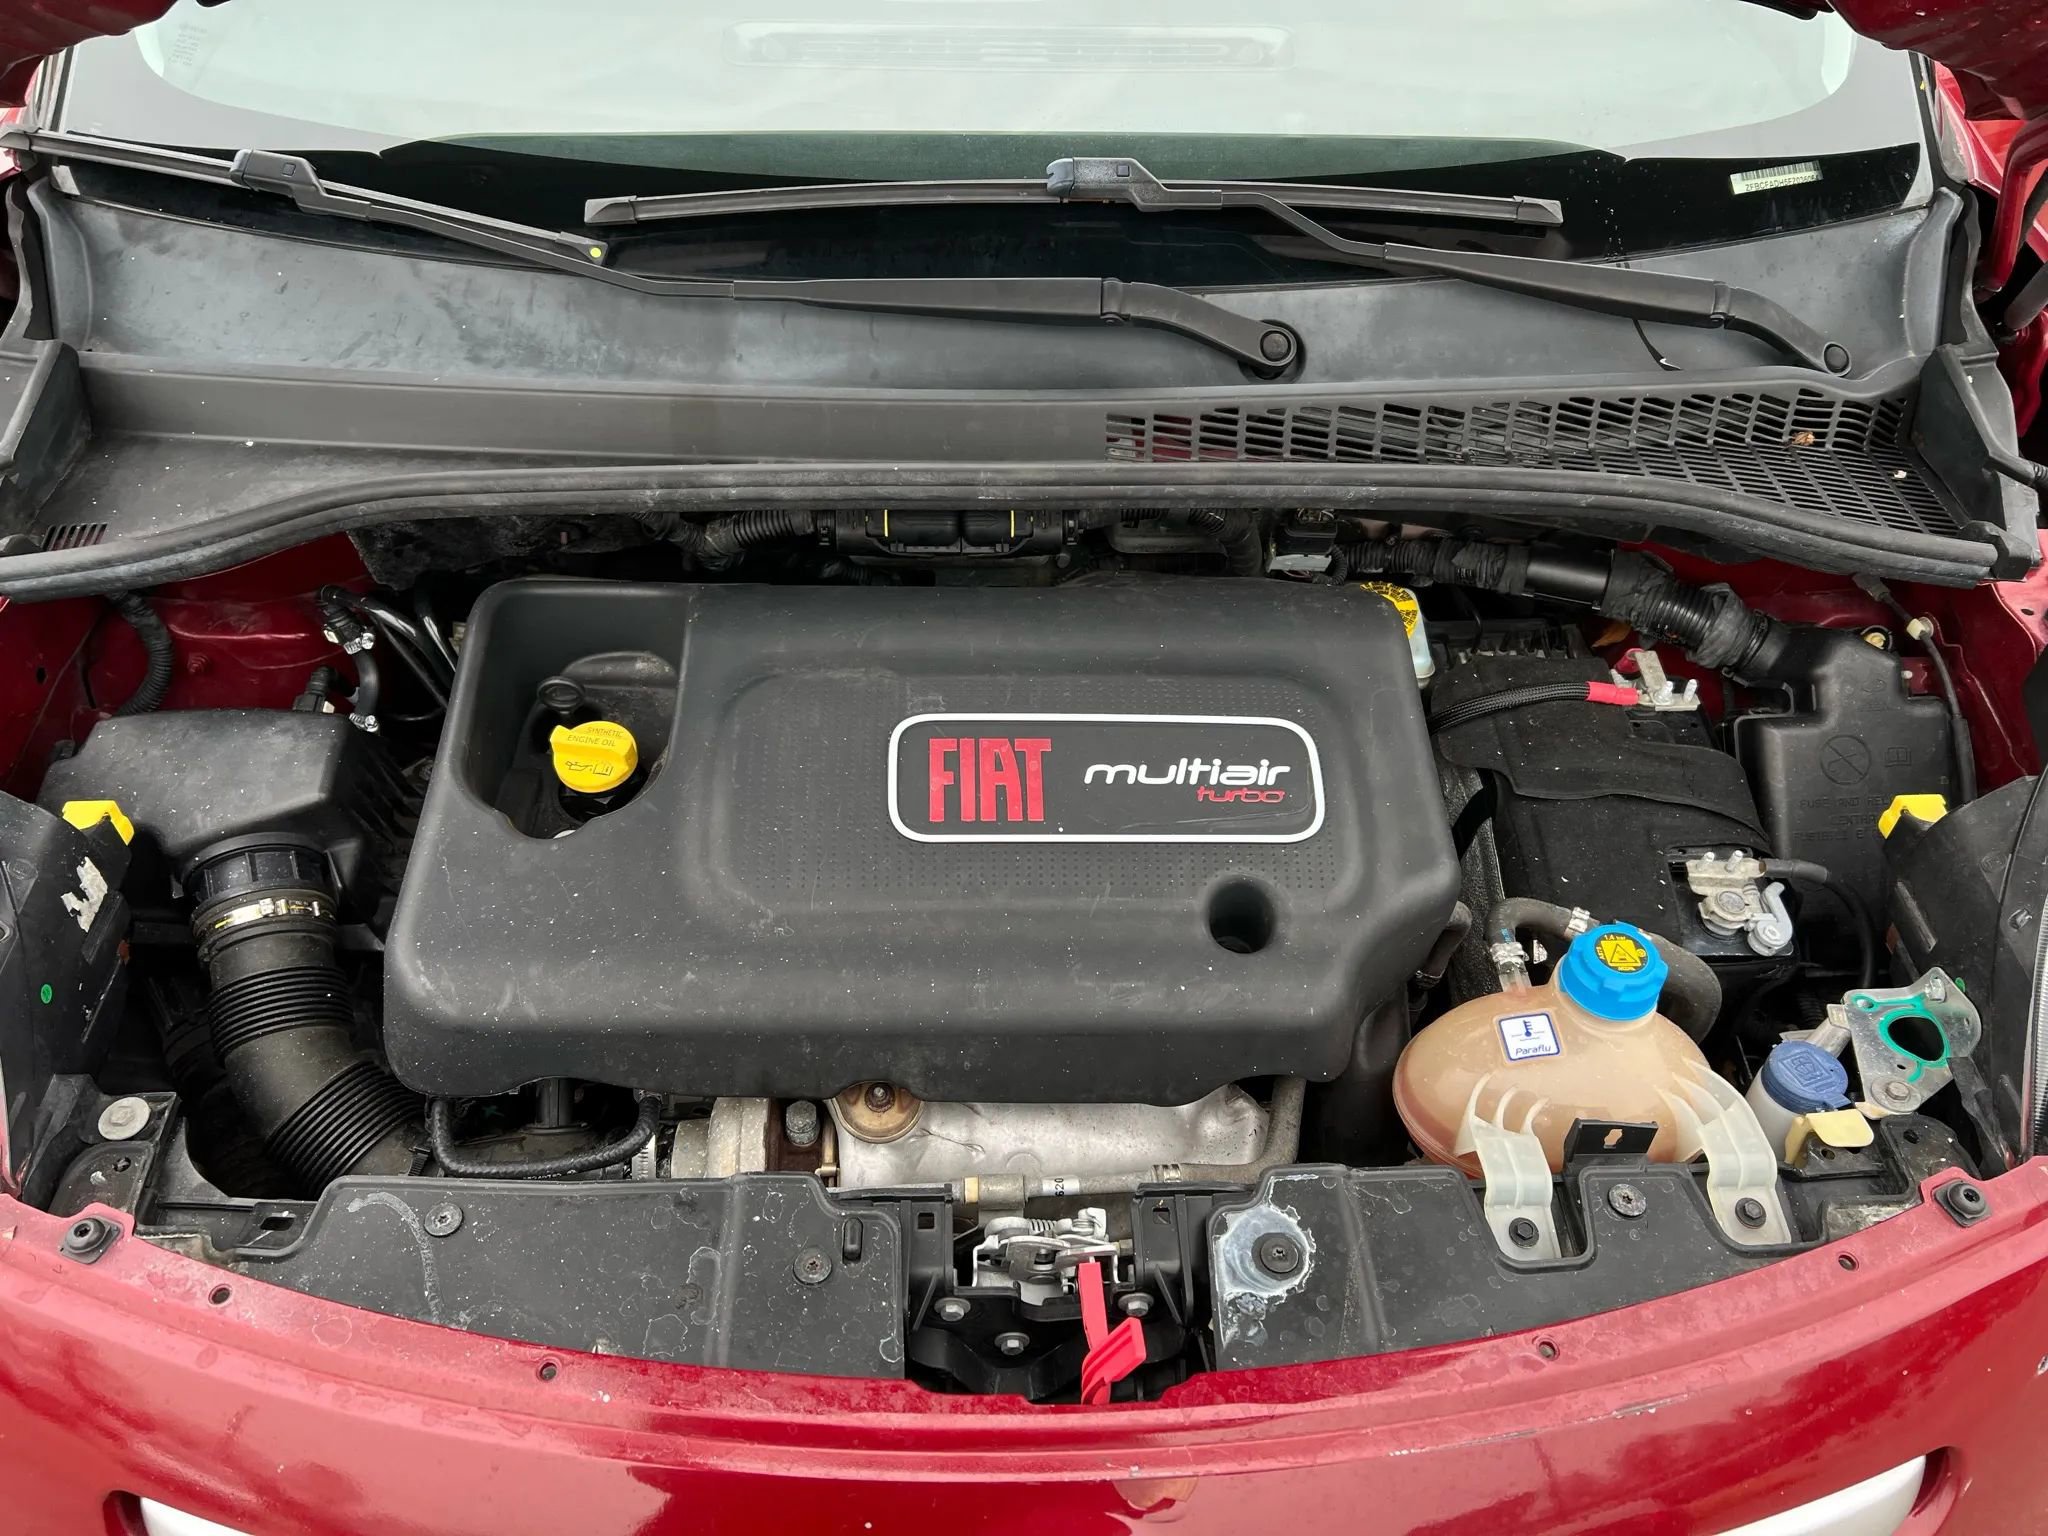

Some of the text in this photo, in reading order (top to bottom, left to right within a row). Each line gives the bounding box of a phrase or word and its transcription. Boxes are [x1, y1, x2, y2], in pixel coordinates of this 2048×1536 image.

[567, 735, 616, 747] ENGINE OIL
[929, 738, 1052, 822] FIAT
[1084, 757, 1291, 786] multiair
[1196, 785, 1286, 803] turbo
[1516, 1044, 1552, 1056] Paraflu
